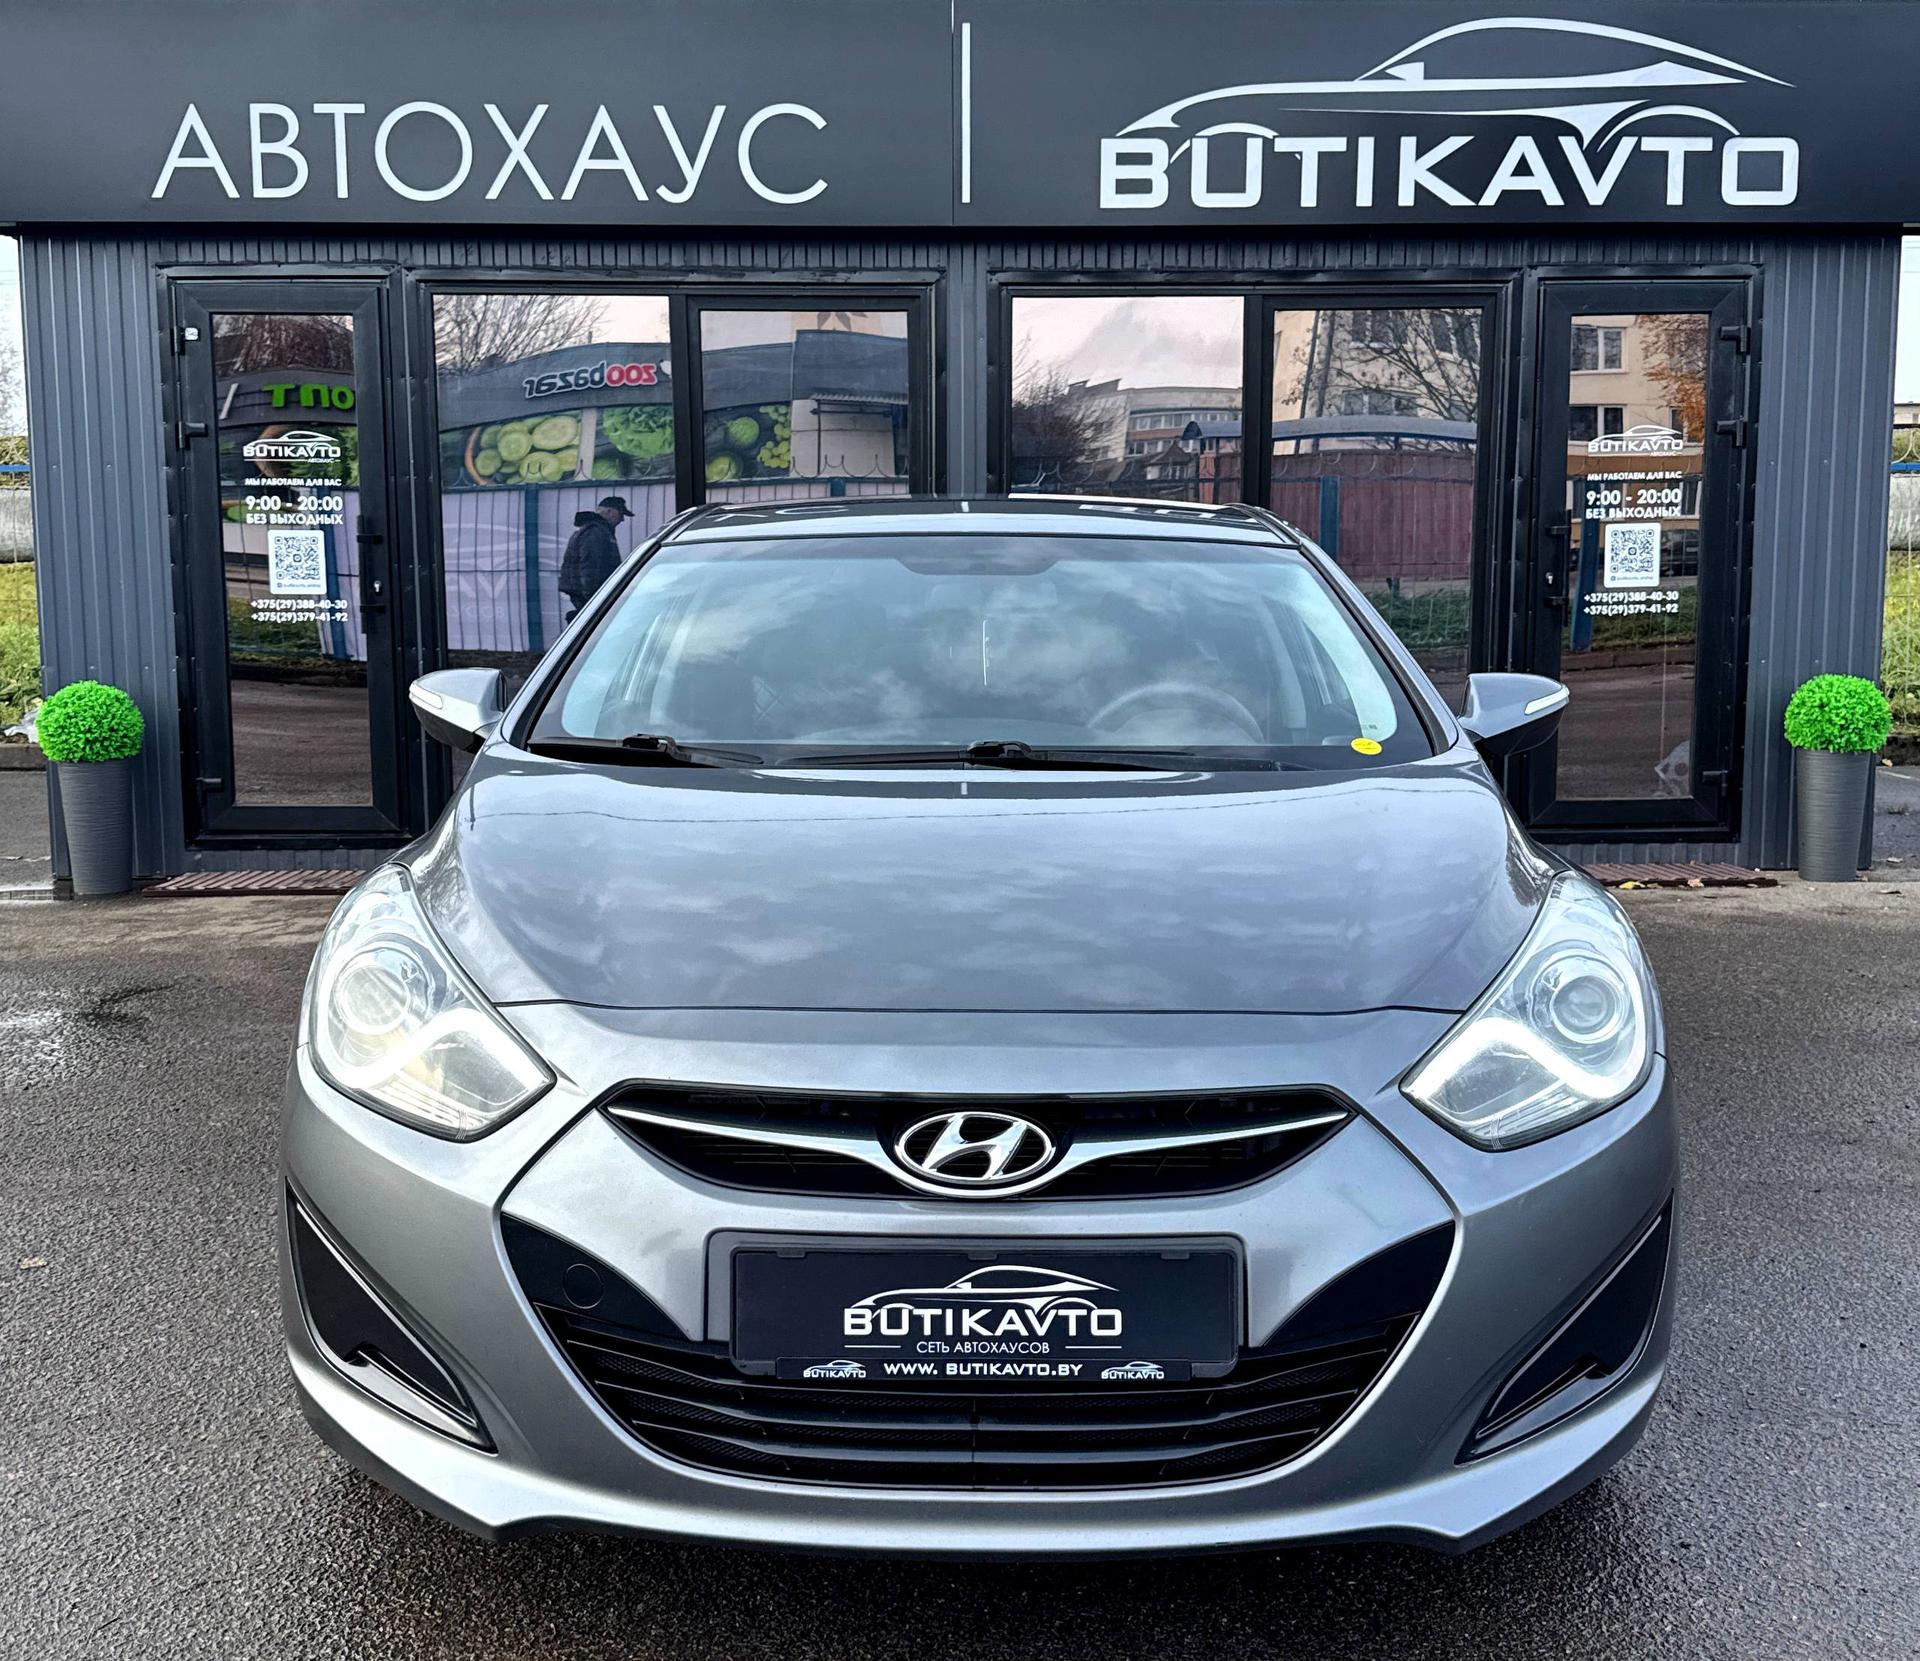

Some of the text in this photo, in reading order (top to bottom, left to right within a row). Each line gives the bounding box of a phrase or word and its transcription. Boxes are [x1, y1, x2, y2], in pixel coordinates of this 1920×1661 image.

[151, 101, 829, 204] АВТОХАУС
[1099, 135, 1799, 209] BUTIKAVTO
[243, 445, 341, 457] BUTIKAVTO
[1588, 439, 1683, 453] BUTIKAVTO
[245, 478, 342, 487] МЫ РАБОТАЕМ ДЛЯ ВАС
[1587, 471, 1683, 481] МЫ РАБОТАЕМ ДЛЯ ВАС
[245, 495, 281, 511] 9:00
[297, 495, 343, 511] 20:00
[1586, 489, 1621, 506] 9:00
[1636, 488, 1681, 505] 20:00
[1585, 506, 1681, 519] БЕЗ ВЫХОДНЫХ
[246, 513, 343, 526] БЕЗ ВЫХОДНЫХ
[1583, 591, 1679, 604] +375(29)388-40-30
[250, 599, 348, 611] +375(29)388-40-30
[1583, 603, 1679, 616] +375(29)379-41-92
[251, 611, 348, 623] +375(29)379-41-92
[843, 1308, 1122, 1337] BUTIKAVTO
[916, 1341, 1050, 1354] СЕТЬ АВТОХАУСОВ
[803, 1369, 867, 1378] BUTIKAVTO
[945, 1363, 1083, 1376] BUTIKAVTO.BY
[1101, 1370, 1165, 1380] BUTIKAVTO
